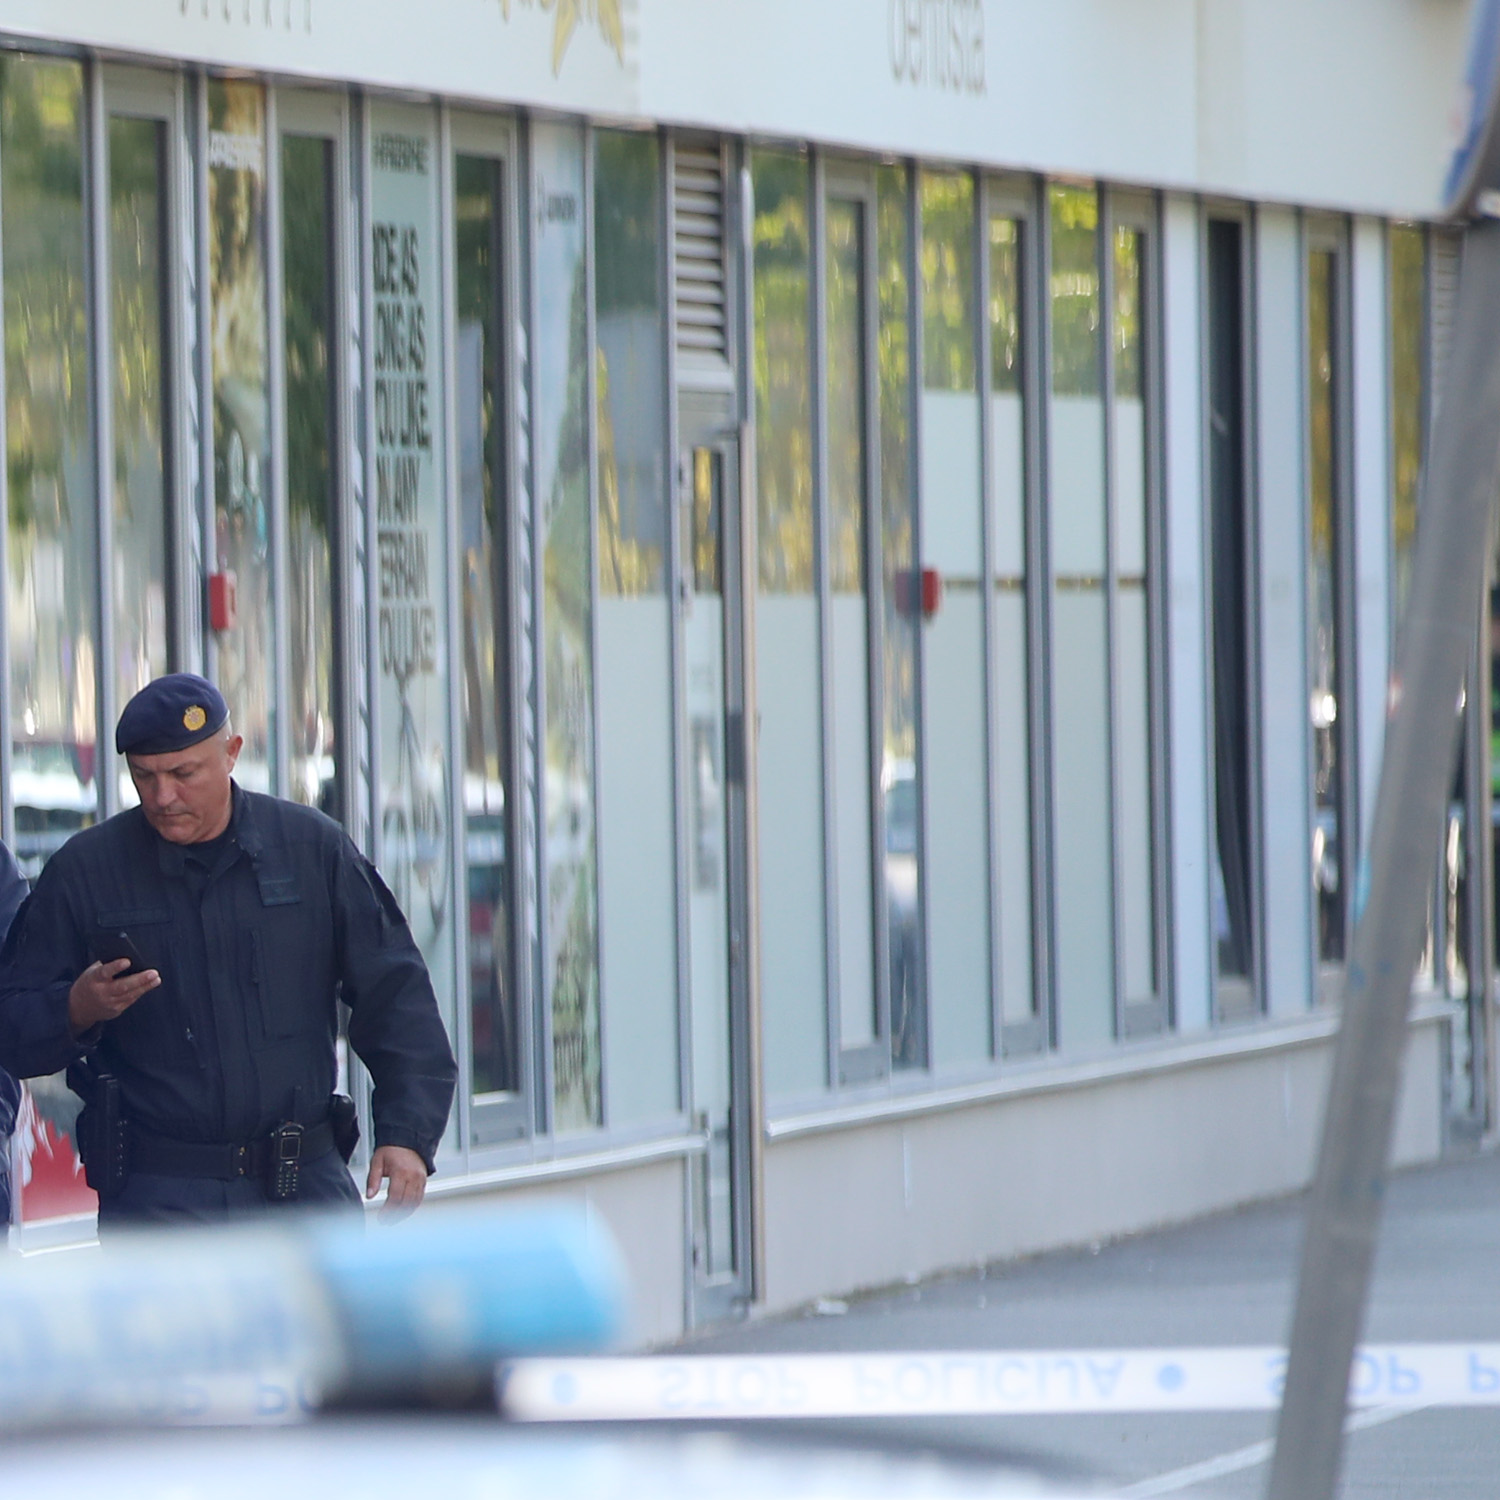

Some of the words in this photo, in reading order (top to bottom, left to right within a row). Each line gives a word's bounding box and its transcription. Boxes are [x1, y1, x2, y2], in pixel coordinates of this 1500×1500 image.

[373, 225, 399, 293] IDE
[375, 302, 406, 371] ONG
[375, 378, 397, 447] OU
[379, 607, 403, 679] OU
